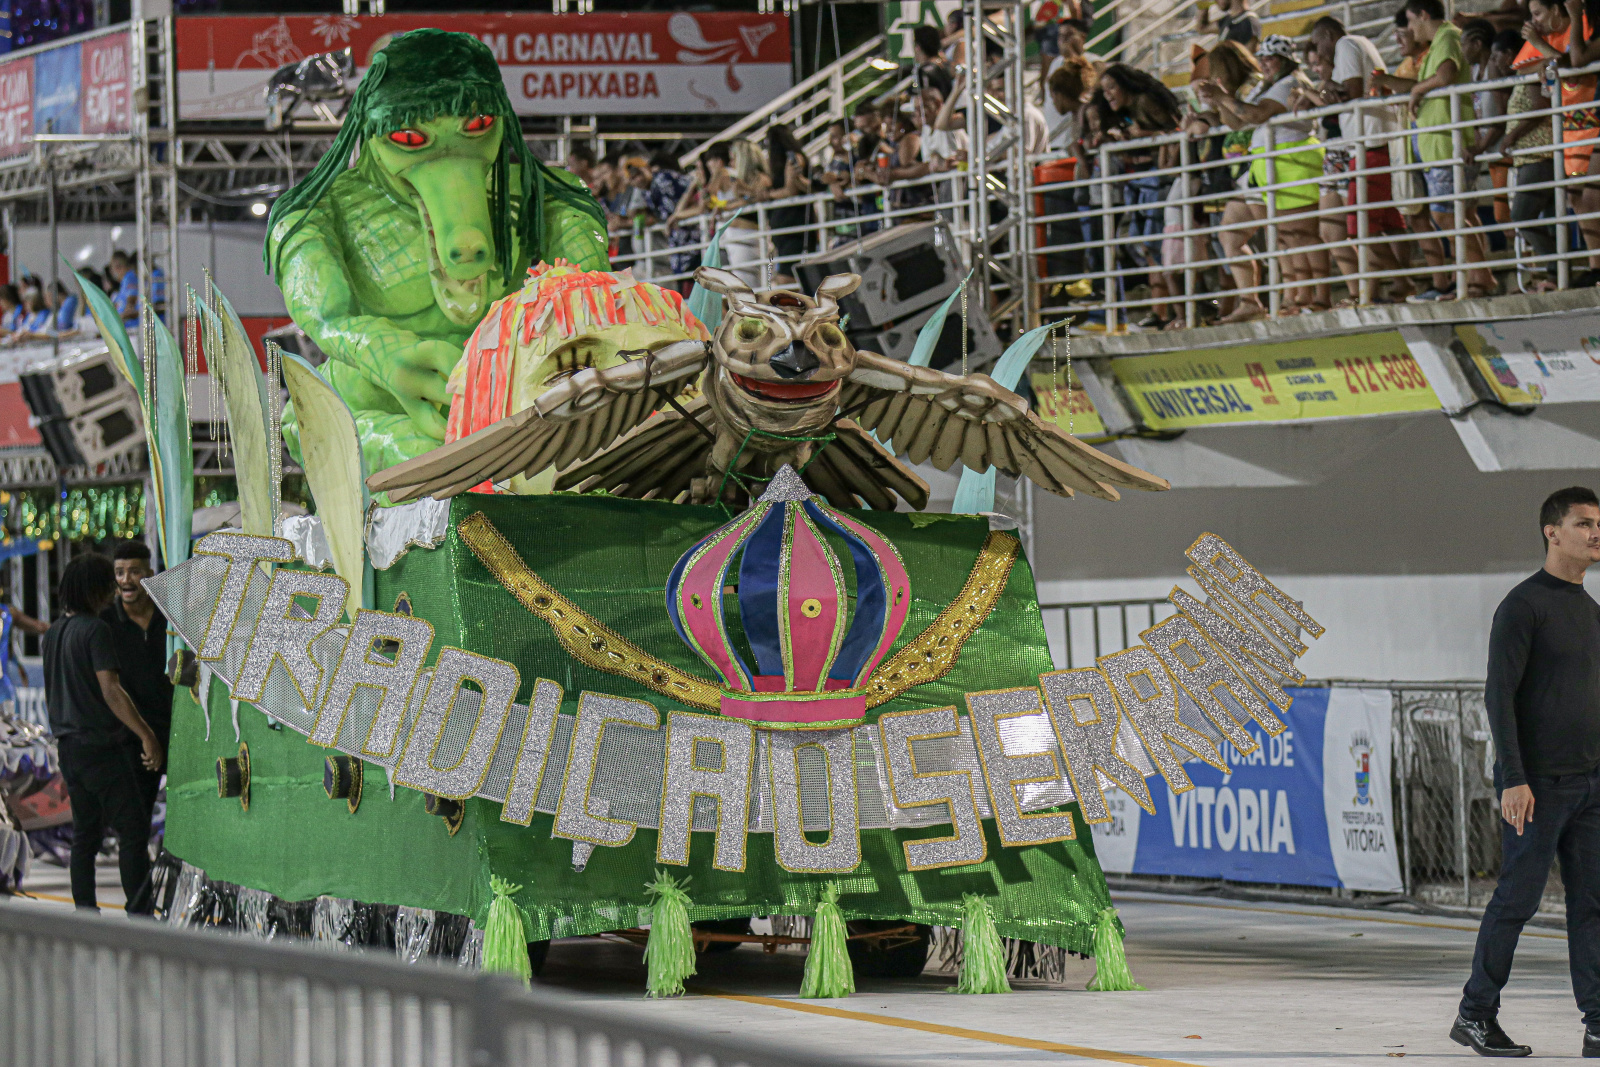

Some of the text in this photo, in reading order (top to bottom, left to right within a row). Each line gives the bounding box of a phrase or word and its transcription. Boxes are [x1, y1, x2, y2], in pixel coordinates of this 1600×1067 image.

[514, 33, 660, 62] CARNAVAL
[522, 72, 661, 99] CAPIXABA
[1244, 361, 1273, 393] 47
[1142, 383, 1254, 419] UNIVERSAL
[877, 531, 1326, 873] SERRANA
[1269, 731, 1295, 767] DE
[1166, 769, 1296, 855] VITÓRIA
[1342, 824, 1387, 852] VITÓRIA
